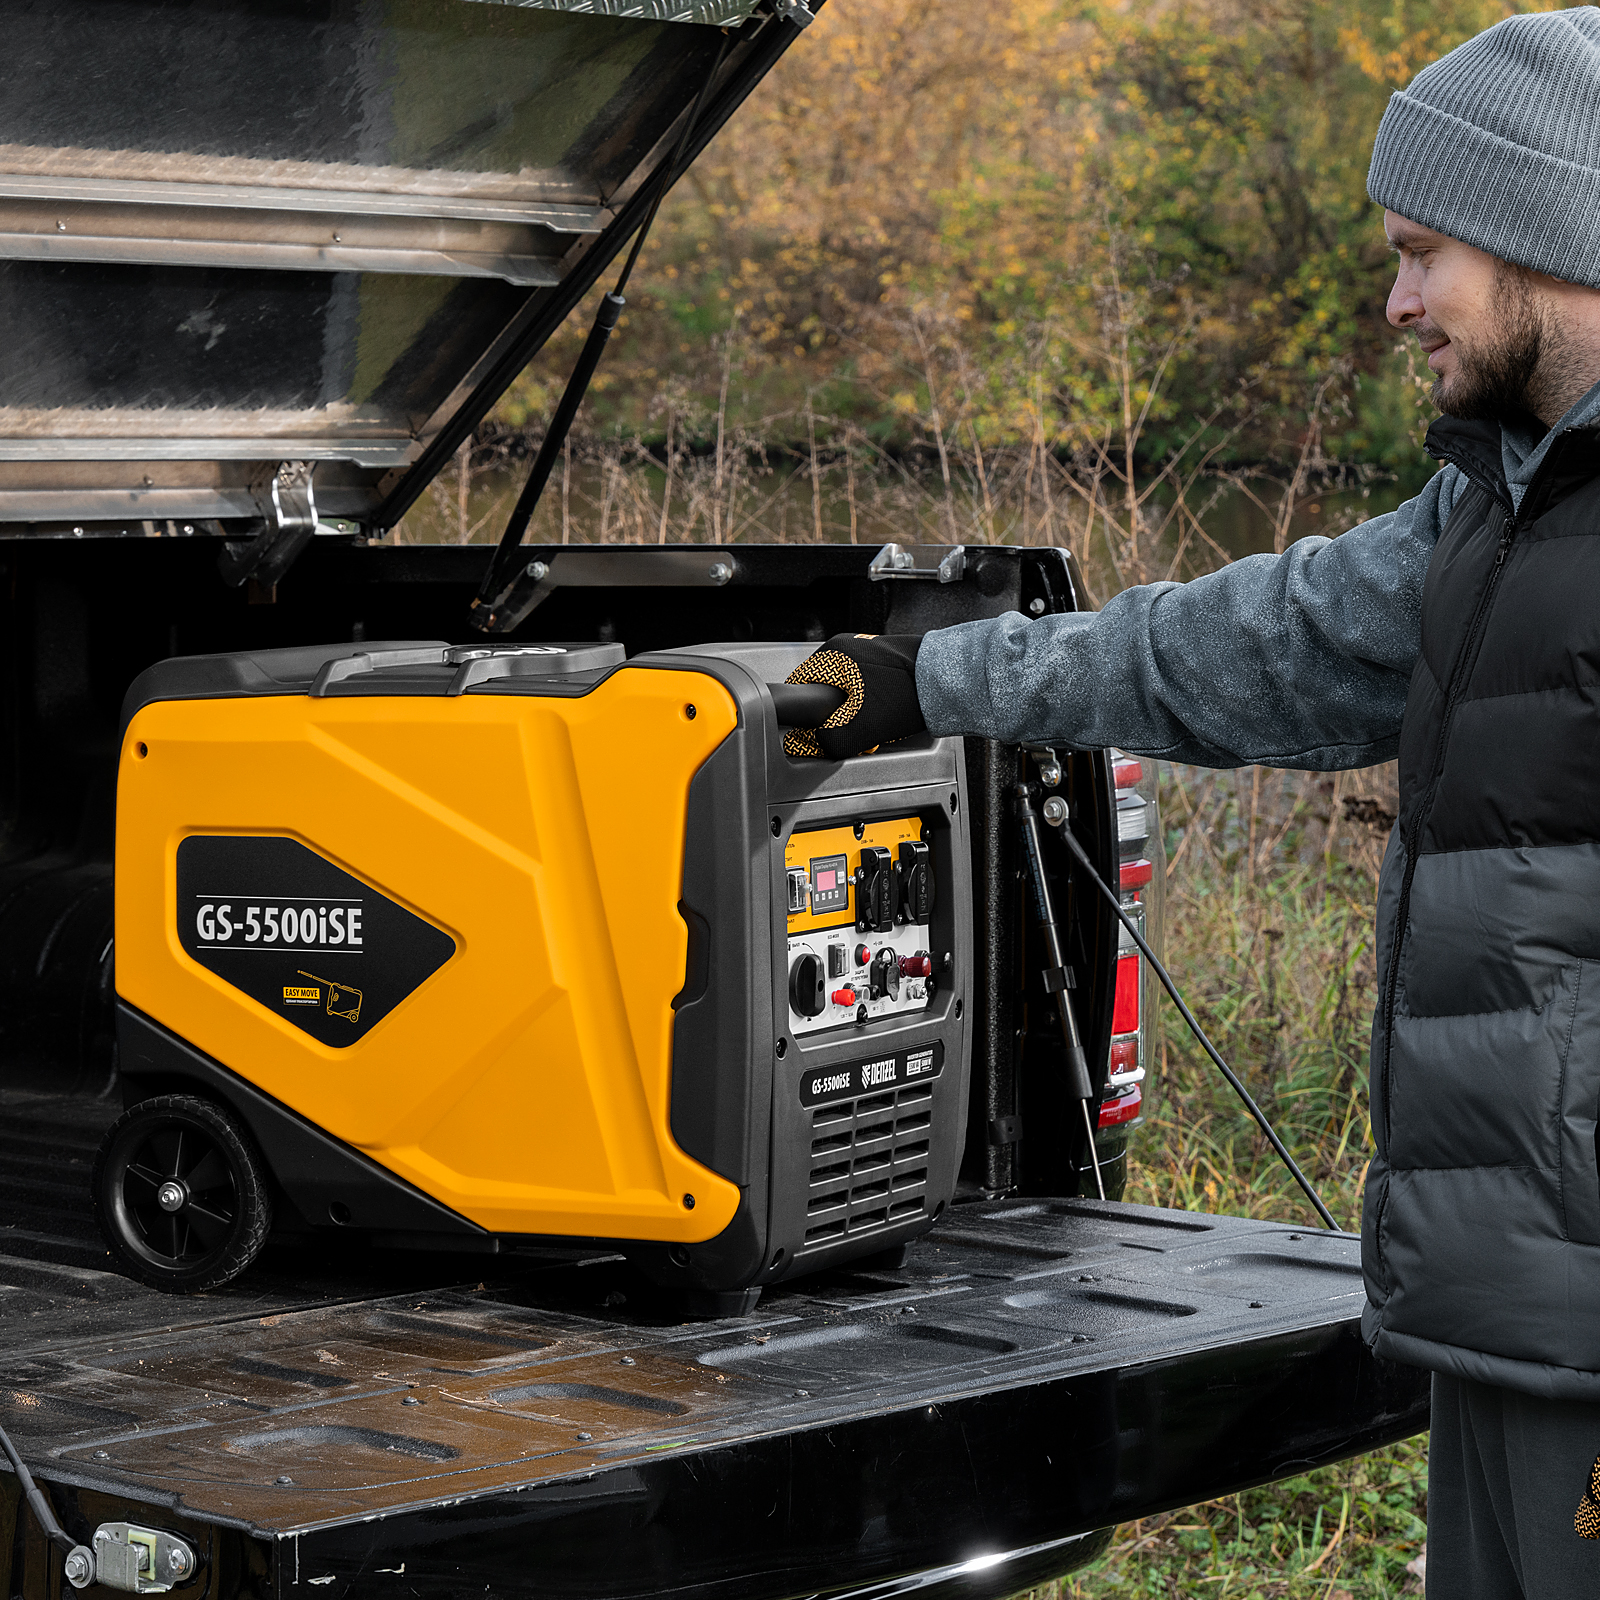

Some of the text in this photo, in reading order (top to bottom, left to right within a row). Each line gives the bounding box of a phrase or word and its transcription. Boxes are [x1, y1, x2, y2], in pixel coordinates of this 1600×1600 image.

[196, 904, 363, 945] GS-5500iSE
[285, 988, 318, 998] EASY MOVE
[812, 1072, 851, 1095] GS-5500iSE
[871, 1059, 897, 1085] DENZEL
